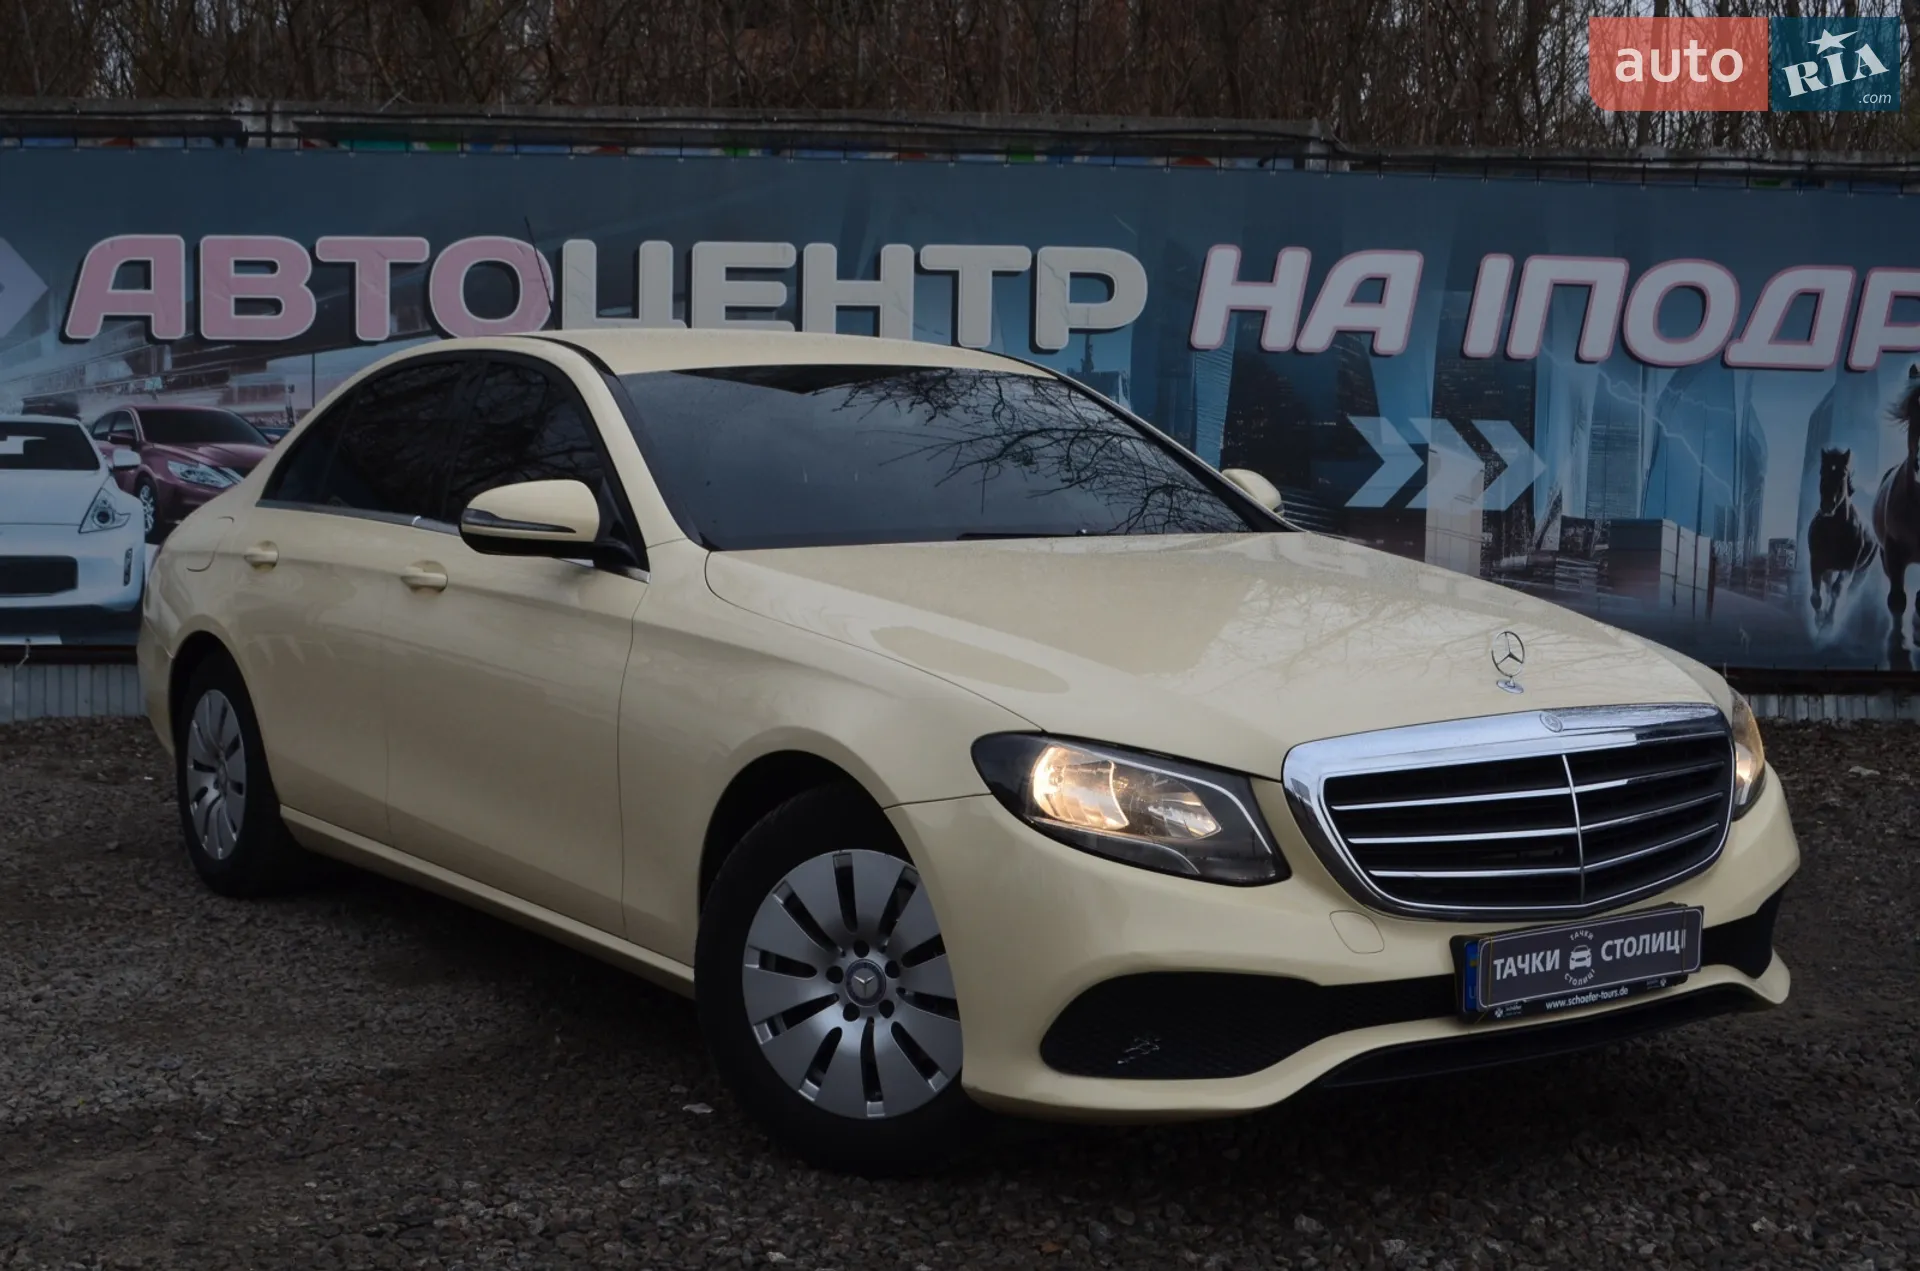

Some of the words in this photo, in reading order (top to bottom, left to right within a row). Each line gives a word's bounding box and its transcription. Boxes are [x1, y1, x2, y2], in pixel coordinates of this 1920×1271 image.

[65, 234, 1148, 349] АВТОЦЕНТР
[1191, 244, 1424, 356] НА
[1493, 949, 1560, 981] ТАЧКИ
